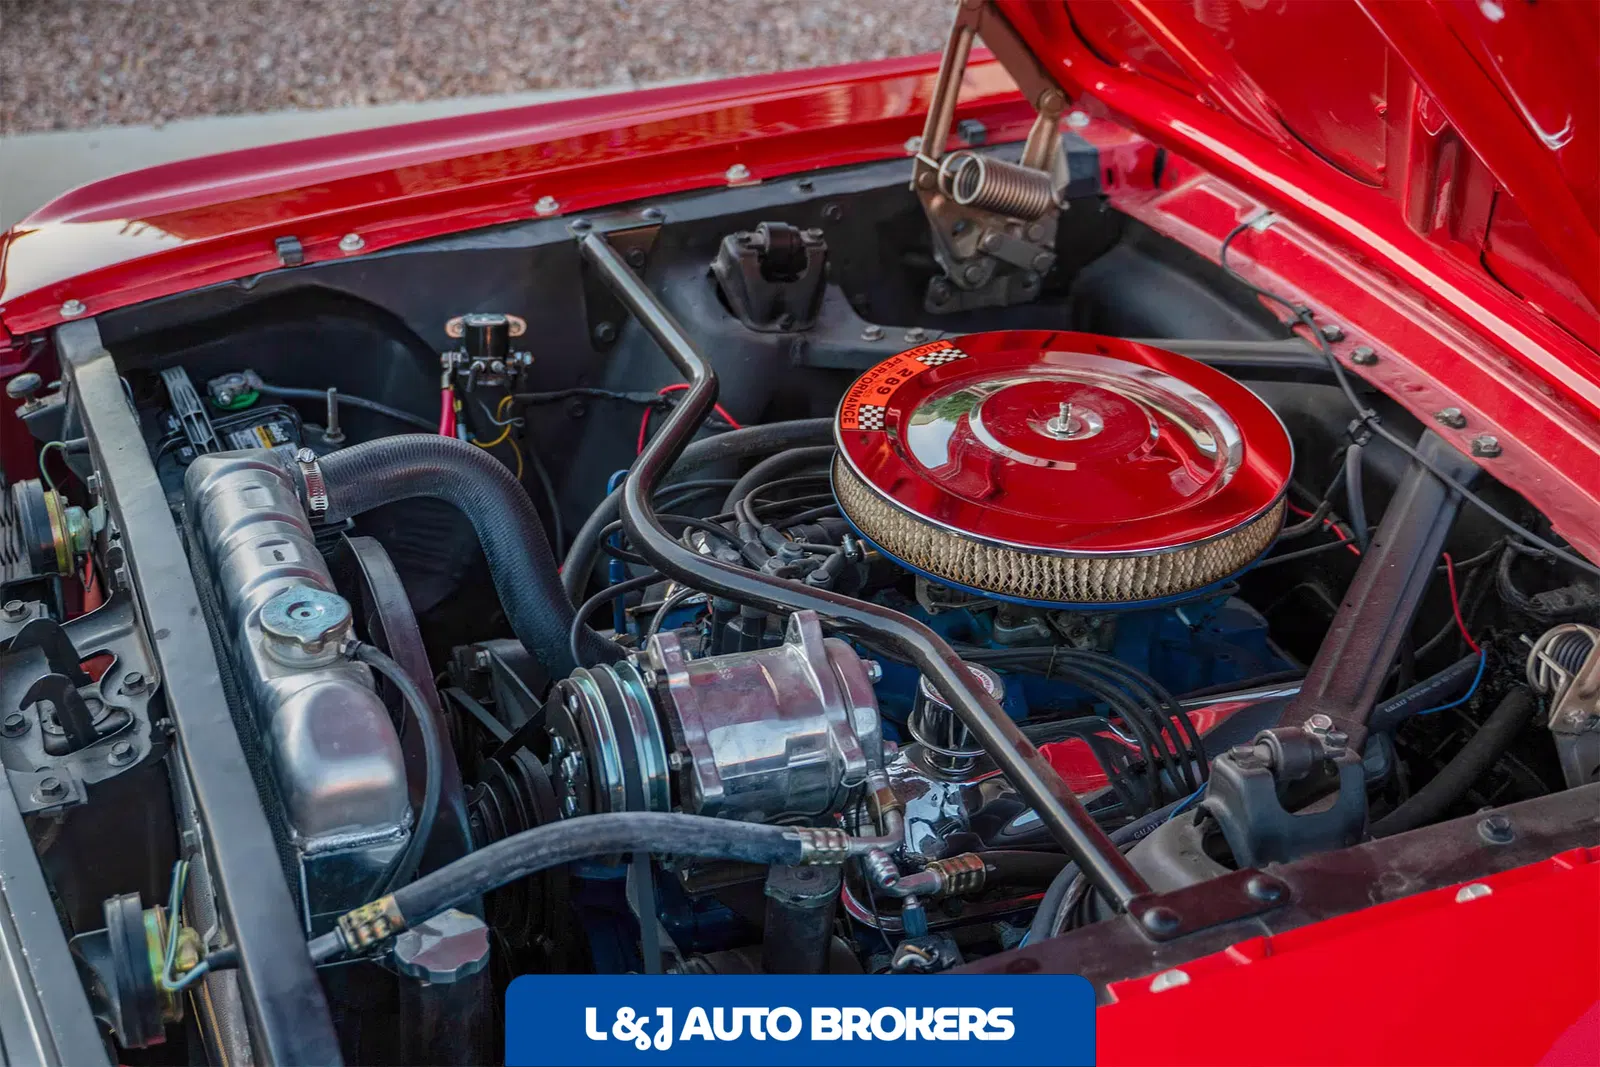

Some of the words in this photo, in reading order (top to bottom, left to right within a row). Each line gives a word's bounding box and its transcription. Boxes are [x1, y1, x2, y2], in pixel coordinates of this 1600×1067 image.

[904, 343, 944, 358] HIGH
[843, 357, 903, 424] PERFORMANCE
[877, 367, 914, 395] 289
